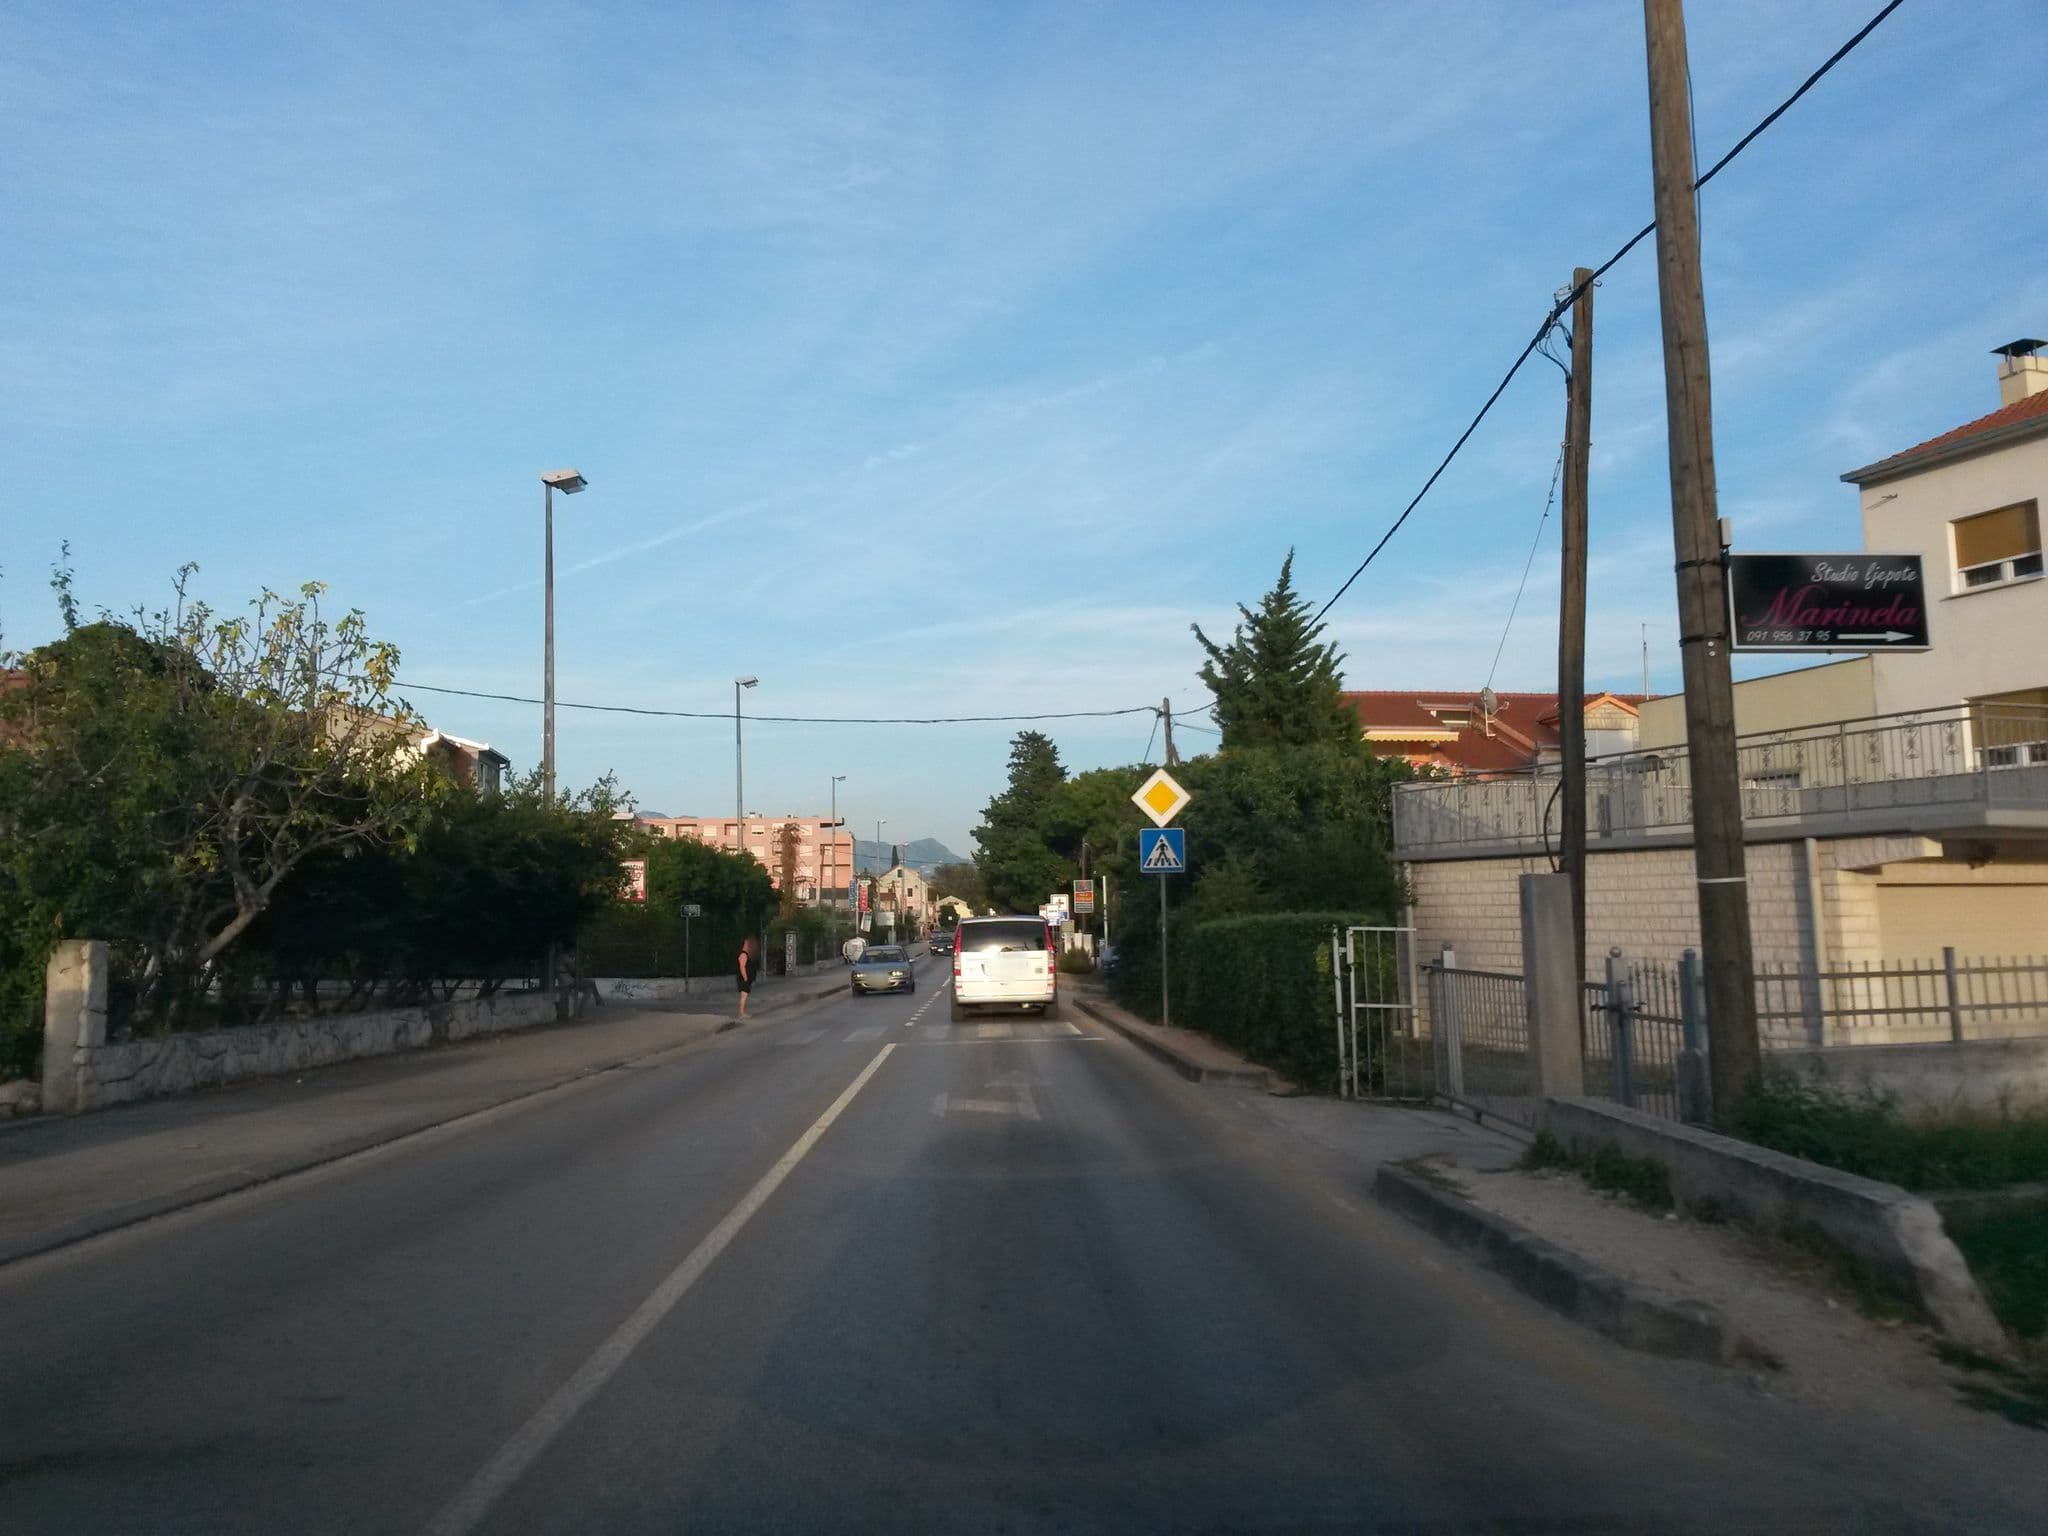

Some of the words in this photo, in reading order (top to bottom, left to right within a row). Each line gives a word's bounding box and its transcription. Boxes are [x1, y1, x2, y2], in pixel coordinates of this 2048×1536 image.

[1811, 562, 1858, 582] Studio
[1864, 562, 1917, 589] ljepote
[1741, 585, 1919, 627] Marinela
[1746, 630, 1768, 641] 091
[1797, 630, 1813, 641] 37
